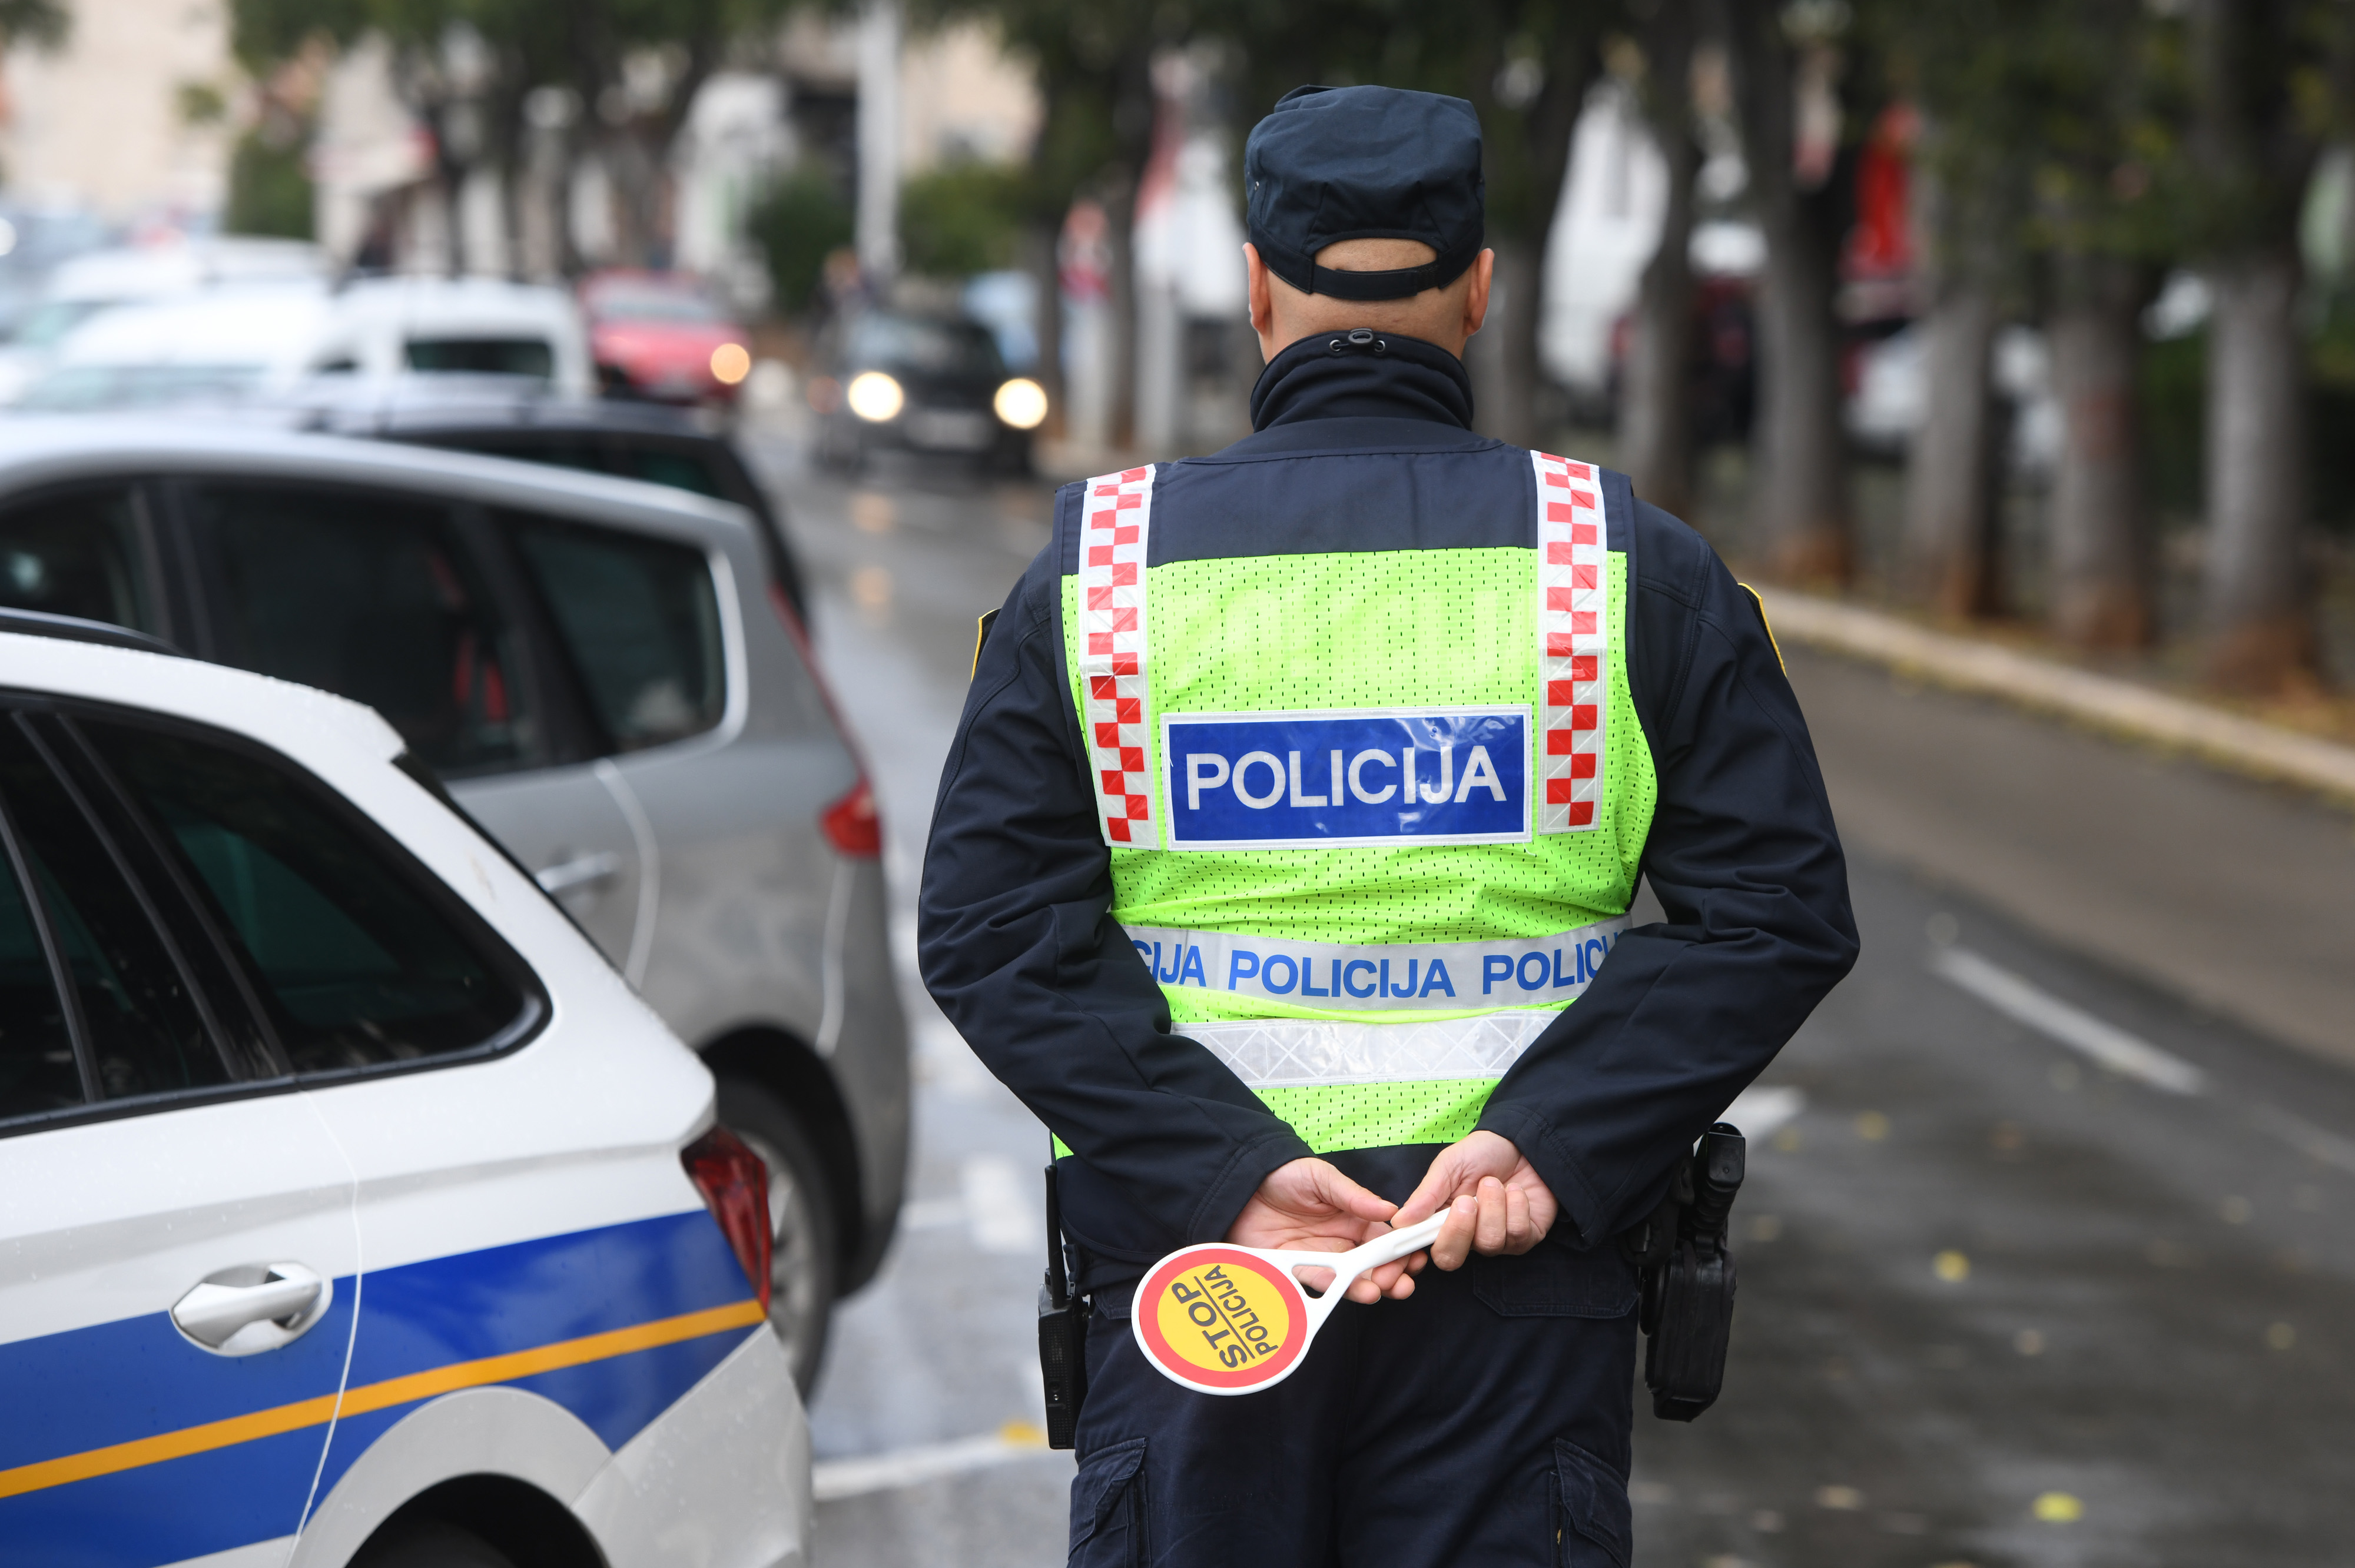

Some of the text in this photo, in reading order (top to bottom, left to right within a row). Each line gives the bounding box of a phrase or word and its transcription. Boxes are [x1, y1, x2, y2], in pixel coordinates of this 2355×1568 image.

[1186, 744, 1507, 810] POLICIJA
[1228, 949, 1454, 998] POLICIJA
[1171, 1282, 1248, 1368] STOP
[1203, 1264, 1279, 1356] POLICIJA
